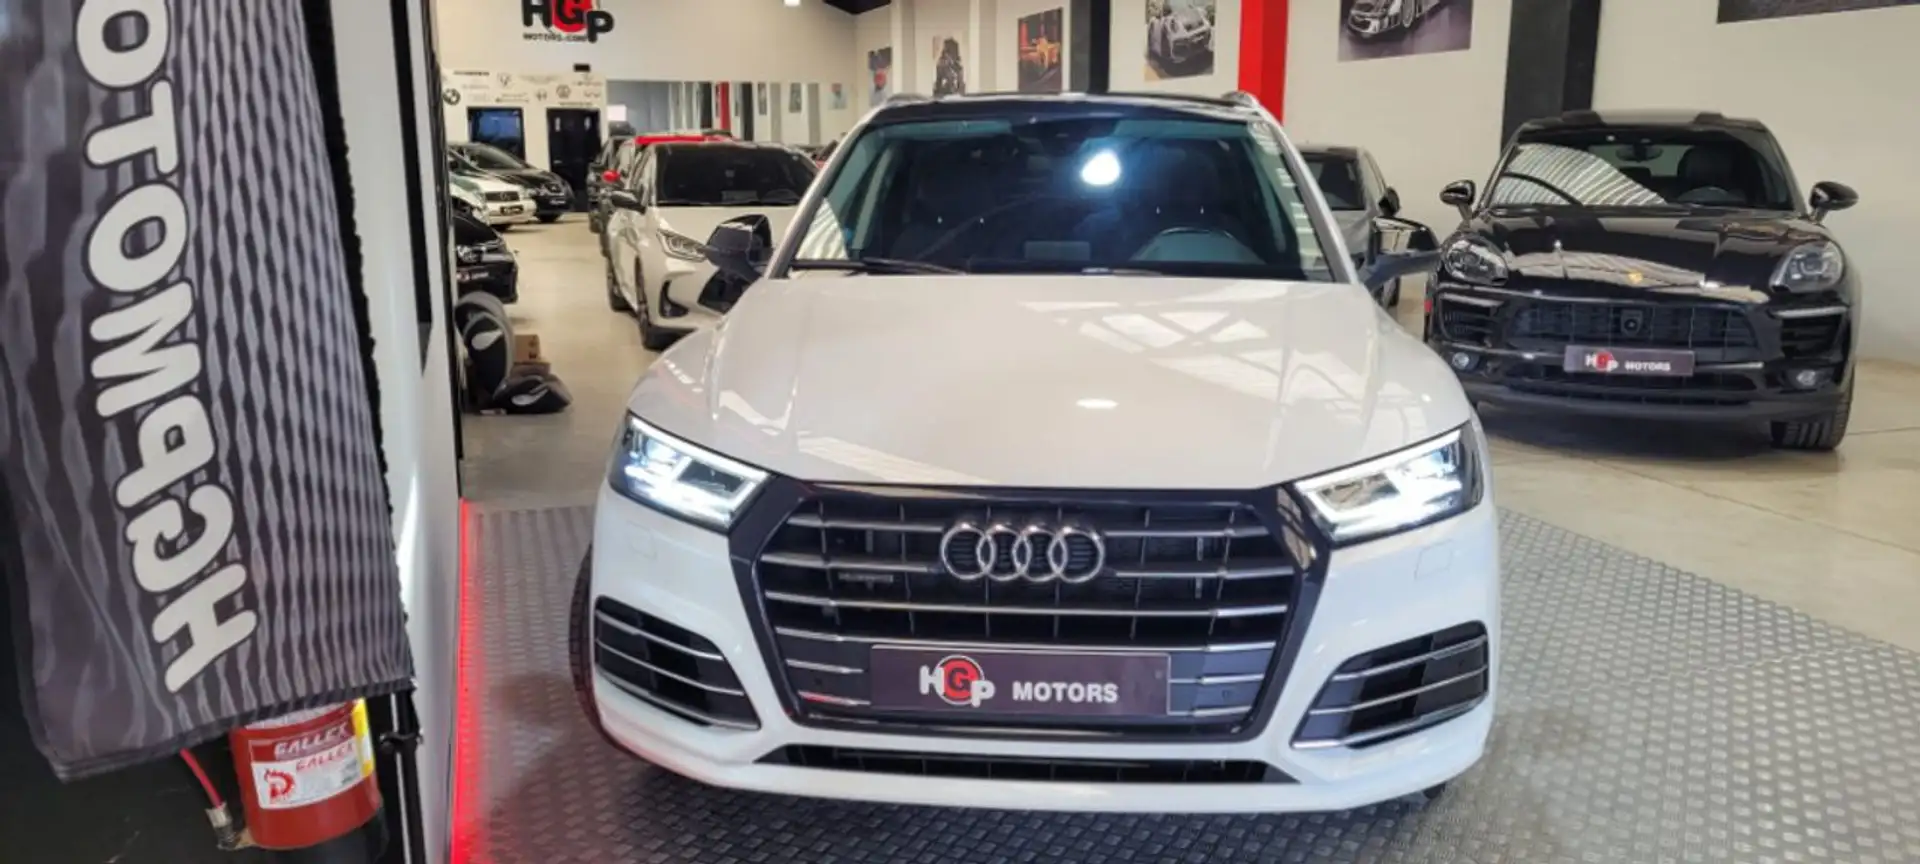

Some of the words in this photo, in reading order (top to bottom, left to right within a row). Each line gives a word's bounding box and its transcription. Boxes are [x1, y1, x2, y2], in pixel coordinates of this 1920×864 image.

[521, 0, 614, 43] HGP
[919, 664, 996, 708] HGP
[1012, 680, 1119, 703] MOTORS
